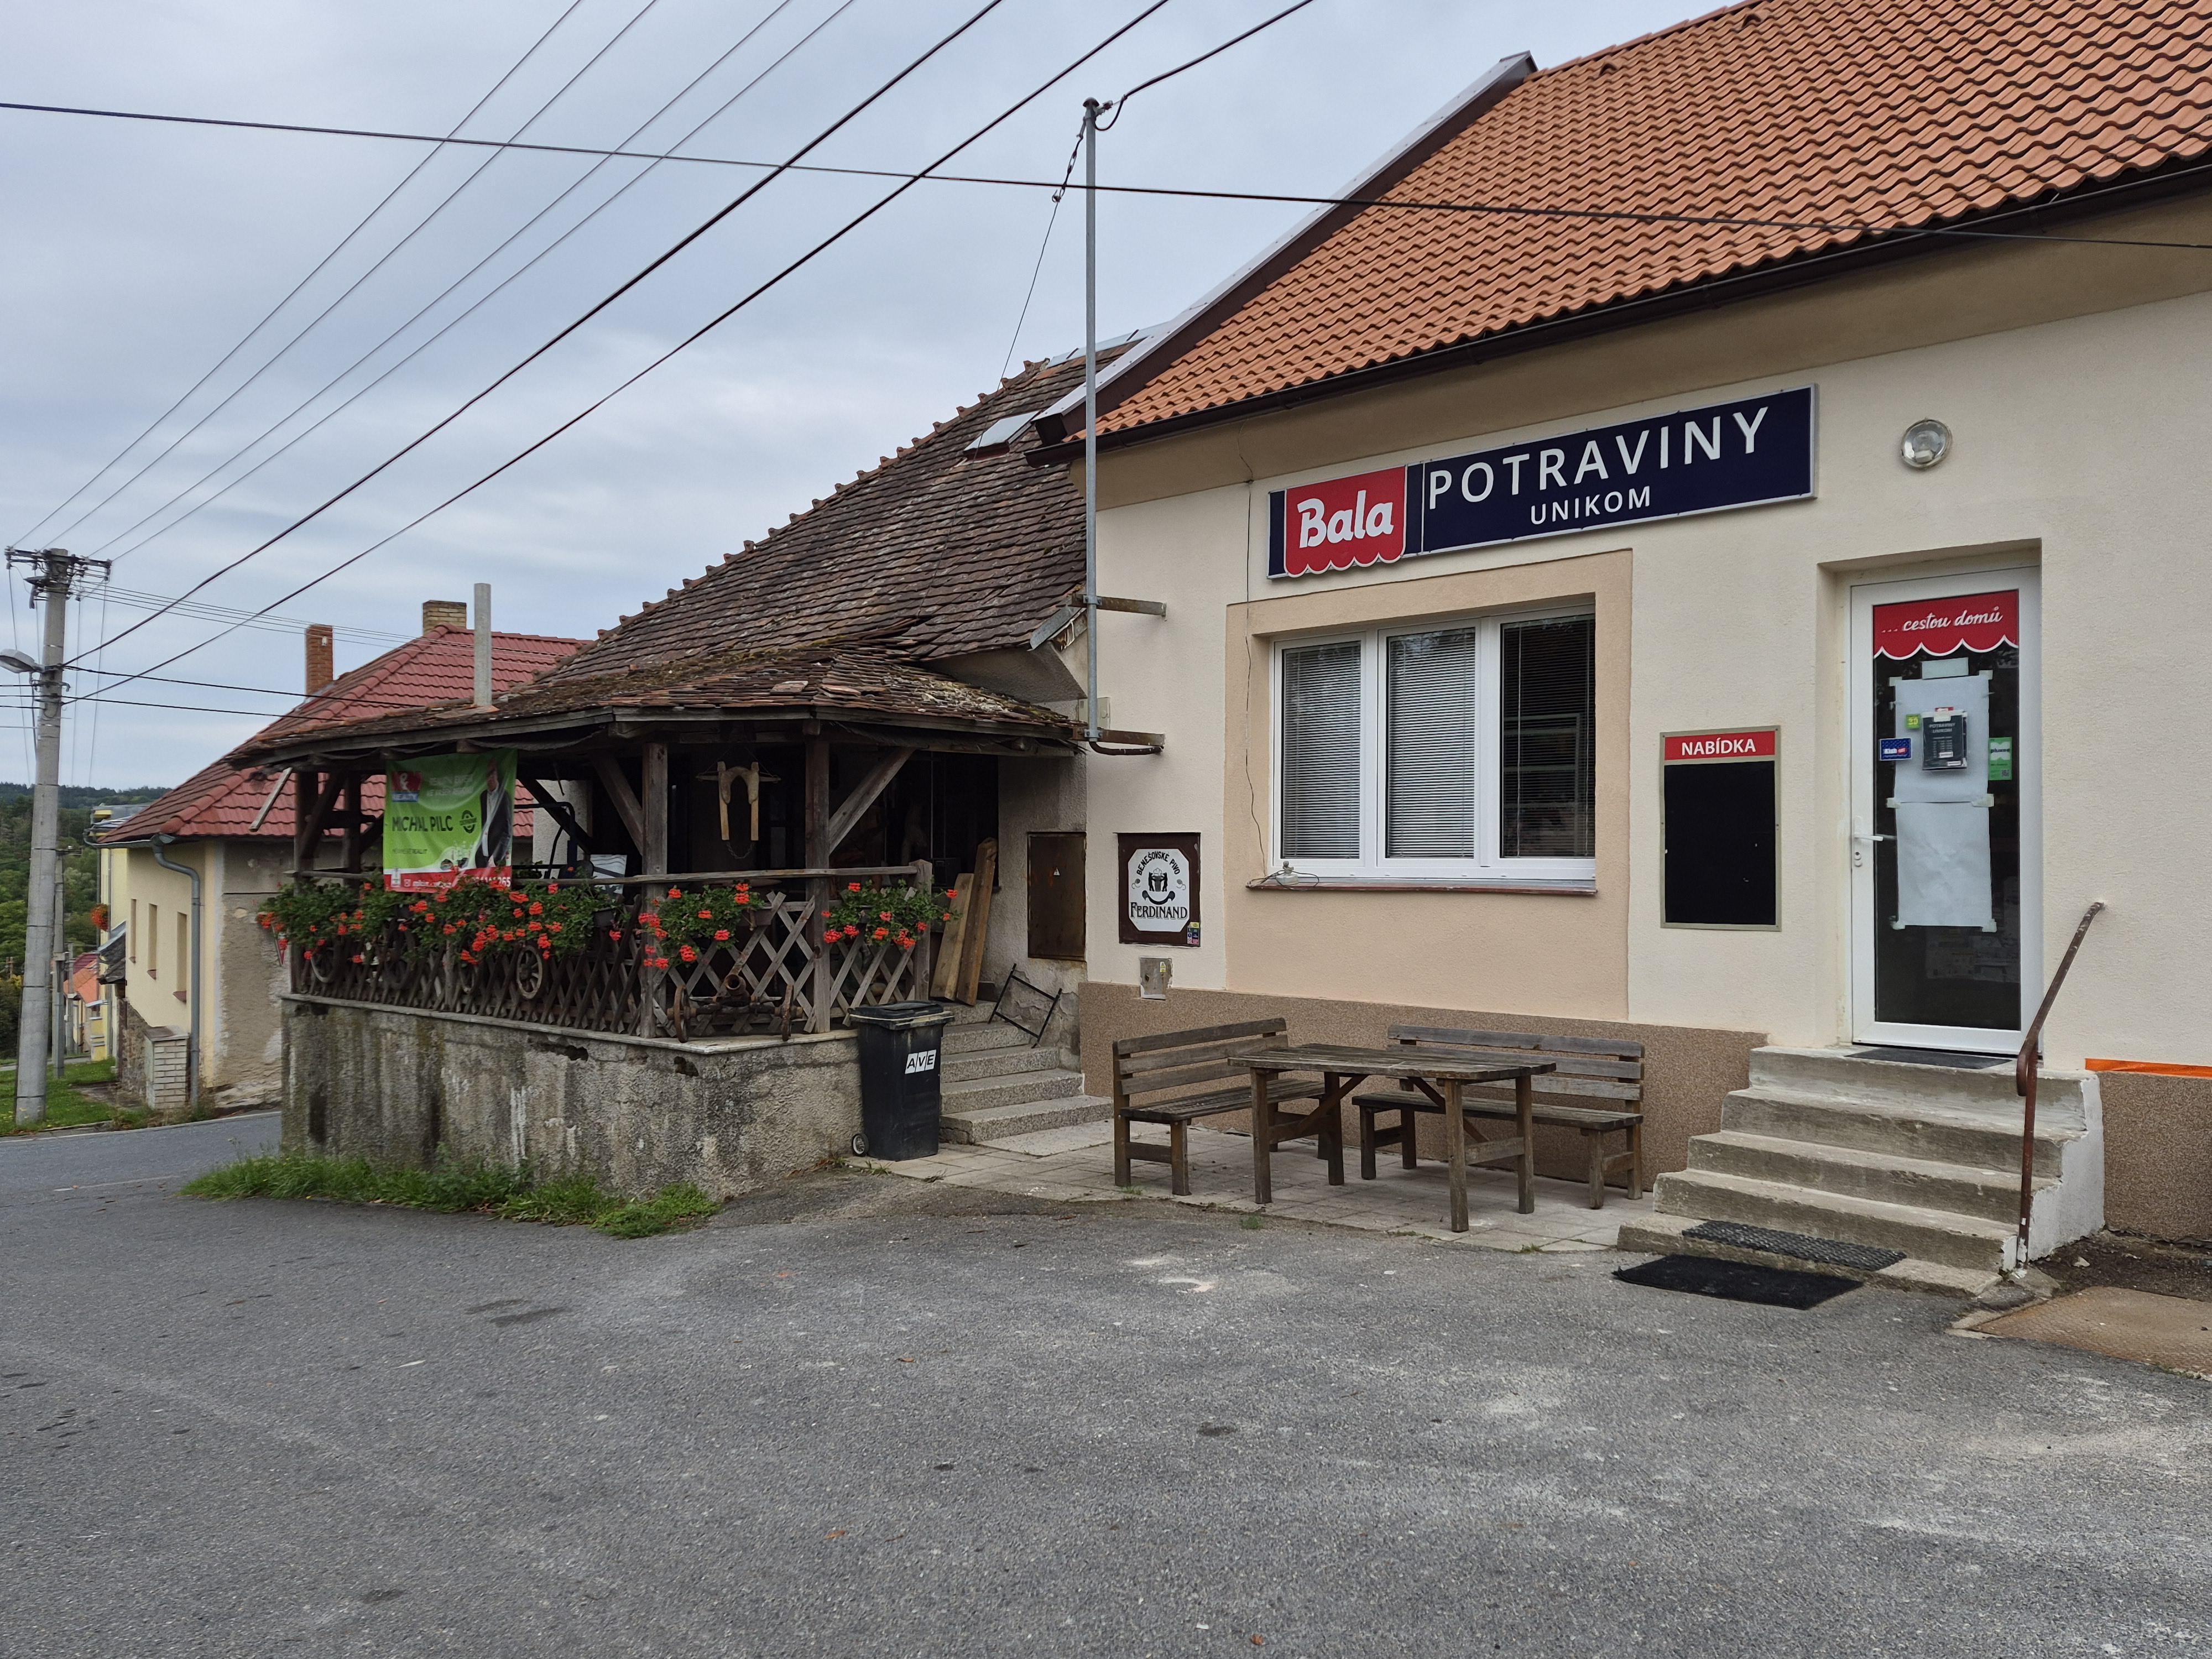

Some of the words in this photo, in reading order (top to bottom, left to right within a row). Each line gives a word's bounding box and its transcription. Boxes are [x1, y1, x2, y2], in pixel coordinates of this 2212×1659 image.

[1429, 406, 1768, 510] POTRAVINY
[1530, 486, 1651, 525] UNIKOM
[1297, 490, 1394, 549] Bala
[1902, 612, 1952, 632] cestou
[1954, 606, 2003, 627] domů
[1682, 737, 1756, 756] NABÍDKA
[430, 815, 453, 832] PILC
[1136, 851, 1170, 876] BENEŠOVSKÉ
[1169, 858, 1181, 875] PIVO
[1130, 902, 1188, 919] FERDINAND
[907, 1054, 935, 1069] AVE
